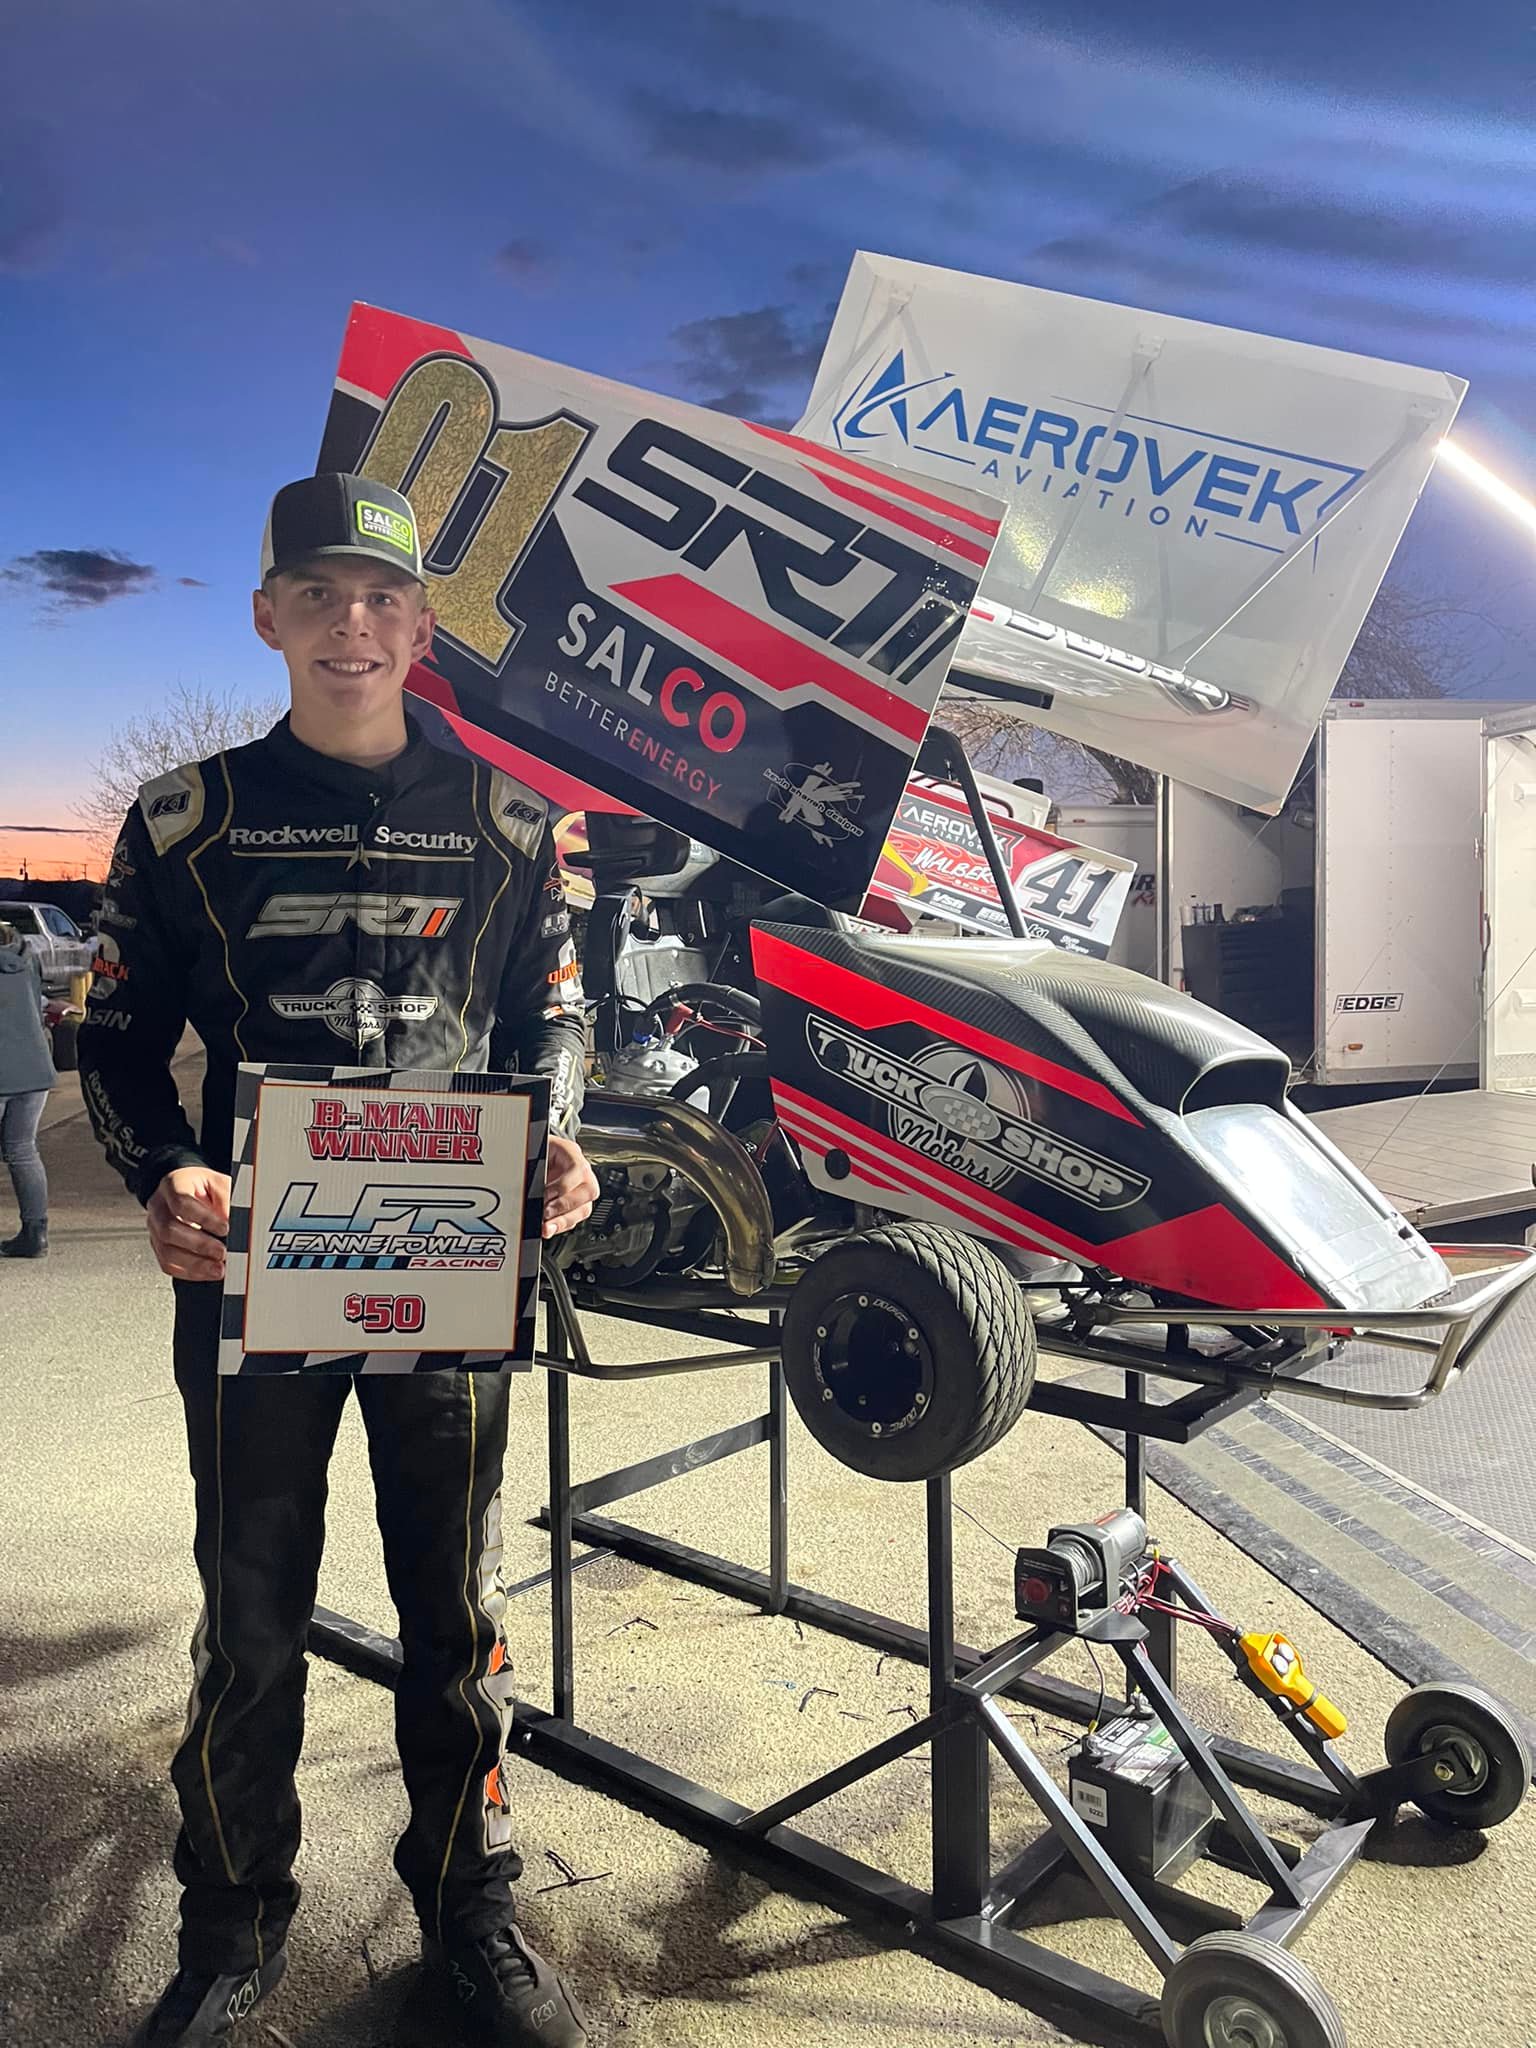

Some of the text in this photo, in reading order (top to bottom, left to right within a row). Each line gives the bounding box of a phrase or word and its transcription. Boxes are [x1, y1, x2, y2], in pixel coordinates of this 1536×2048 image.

[916, 388, 1323, 534] AEROVEK
[355, 351, 600, 677] 01
[980, 458, 1209, 539] AVIATION
[363, 508, 409, 536] SALCO
[556, 601, 748, 753] SALCO
[227, 823, 479, 855] Rockwell Security
[903, 806, 1008, 852] AEROVK
[1024, 857, 1120, 929] 41
[280, 1001, 429, 1014] TRUCK SHOP
[1342, 996, 1398, 1010] EDGE
[311, 1098, 483, 1134] B-MAIN
[305, 1127, 485, 1165] WINNER
[900, 1117, 996, 1190] Motors
[1000, 1125, 1125, 1200] SHOP
[268, 1182, 506, 1236] LFR
[267, 1233, 507, 1257] LEANNE FOWLER
[408, 1257, 502, 1270] RACING
[344, 1293, 426, 1334] $50
